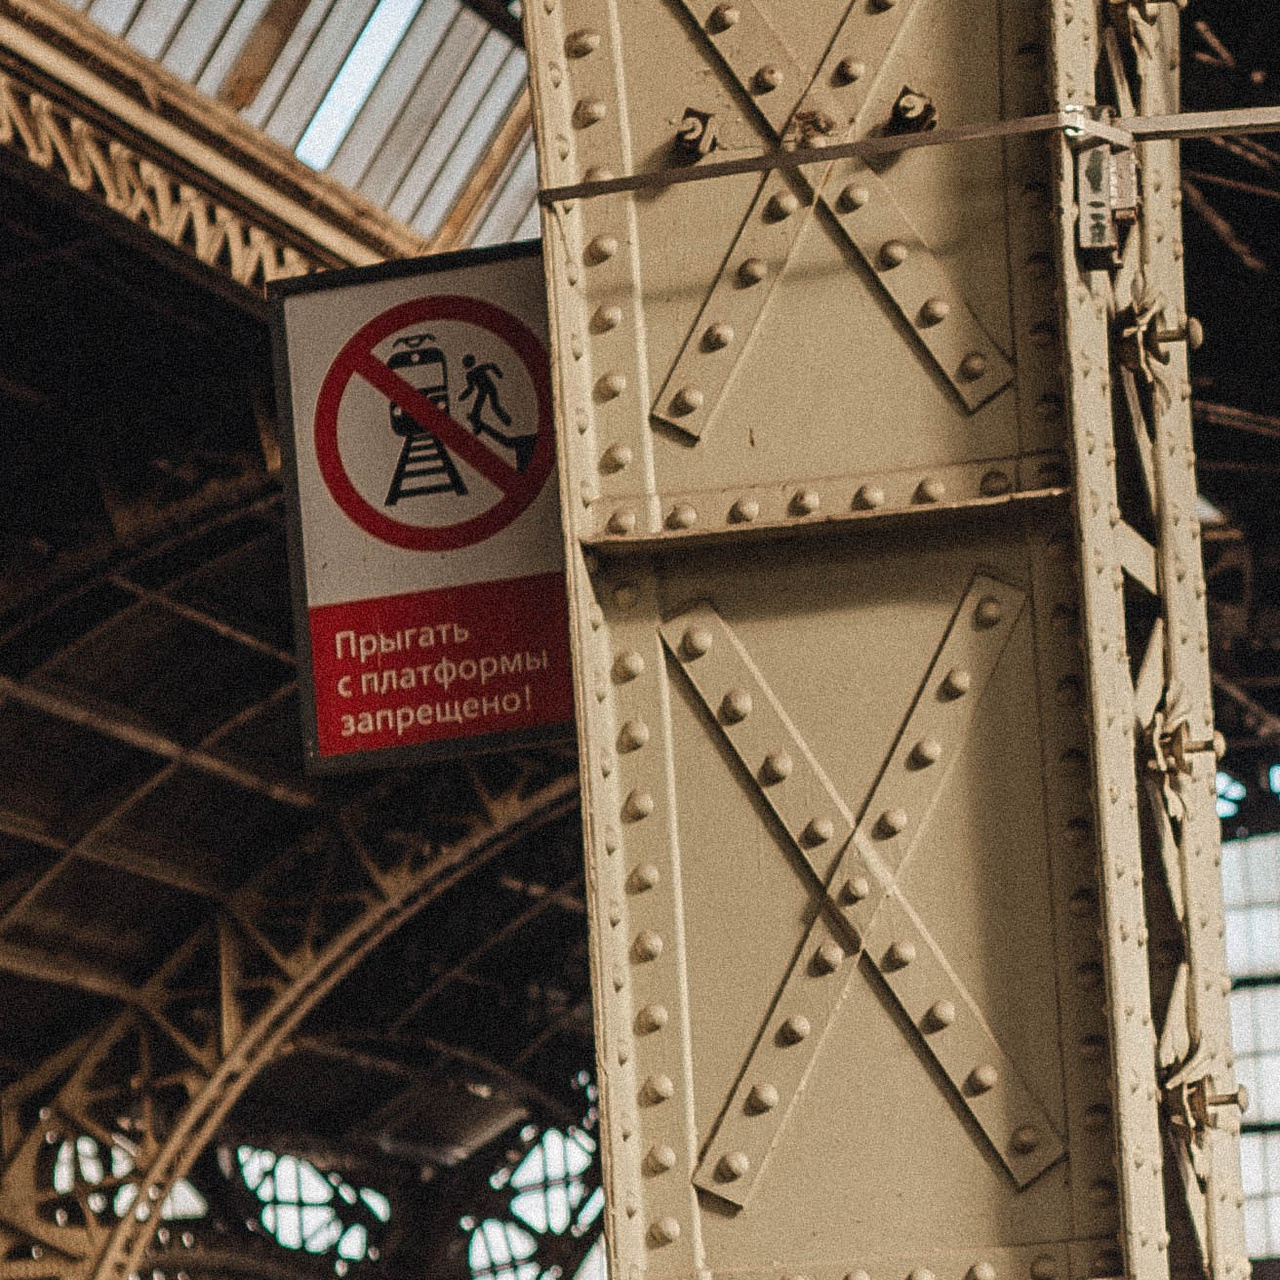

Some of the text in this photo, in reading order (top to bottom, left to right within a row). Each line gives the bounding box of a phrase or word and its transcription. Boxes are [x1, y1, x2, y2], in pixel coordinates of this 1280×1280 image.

[334, 623, 469, 663] Прыгать
[336, 648, 548, 698] с платформы
[340, 683, 532, 736] запрещено!
